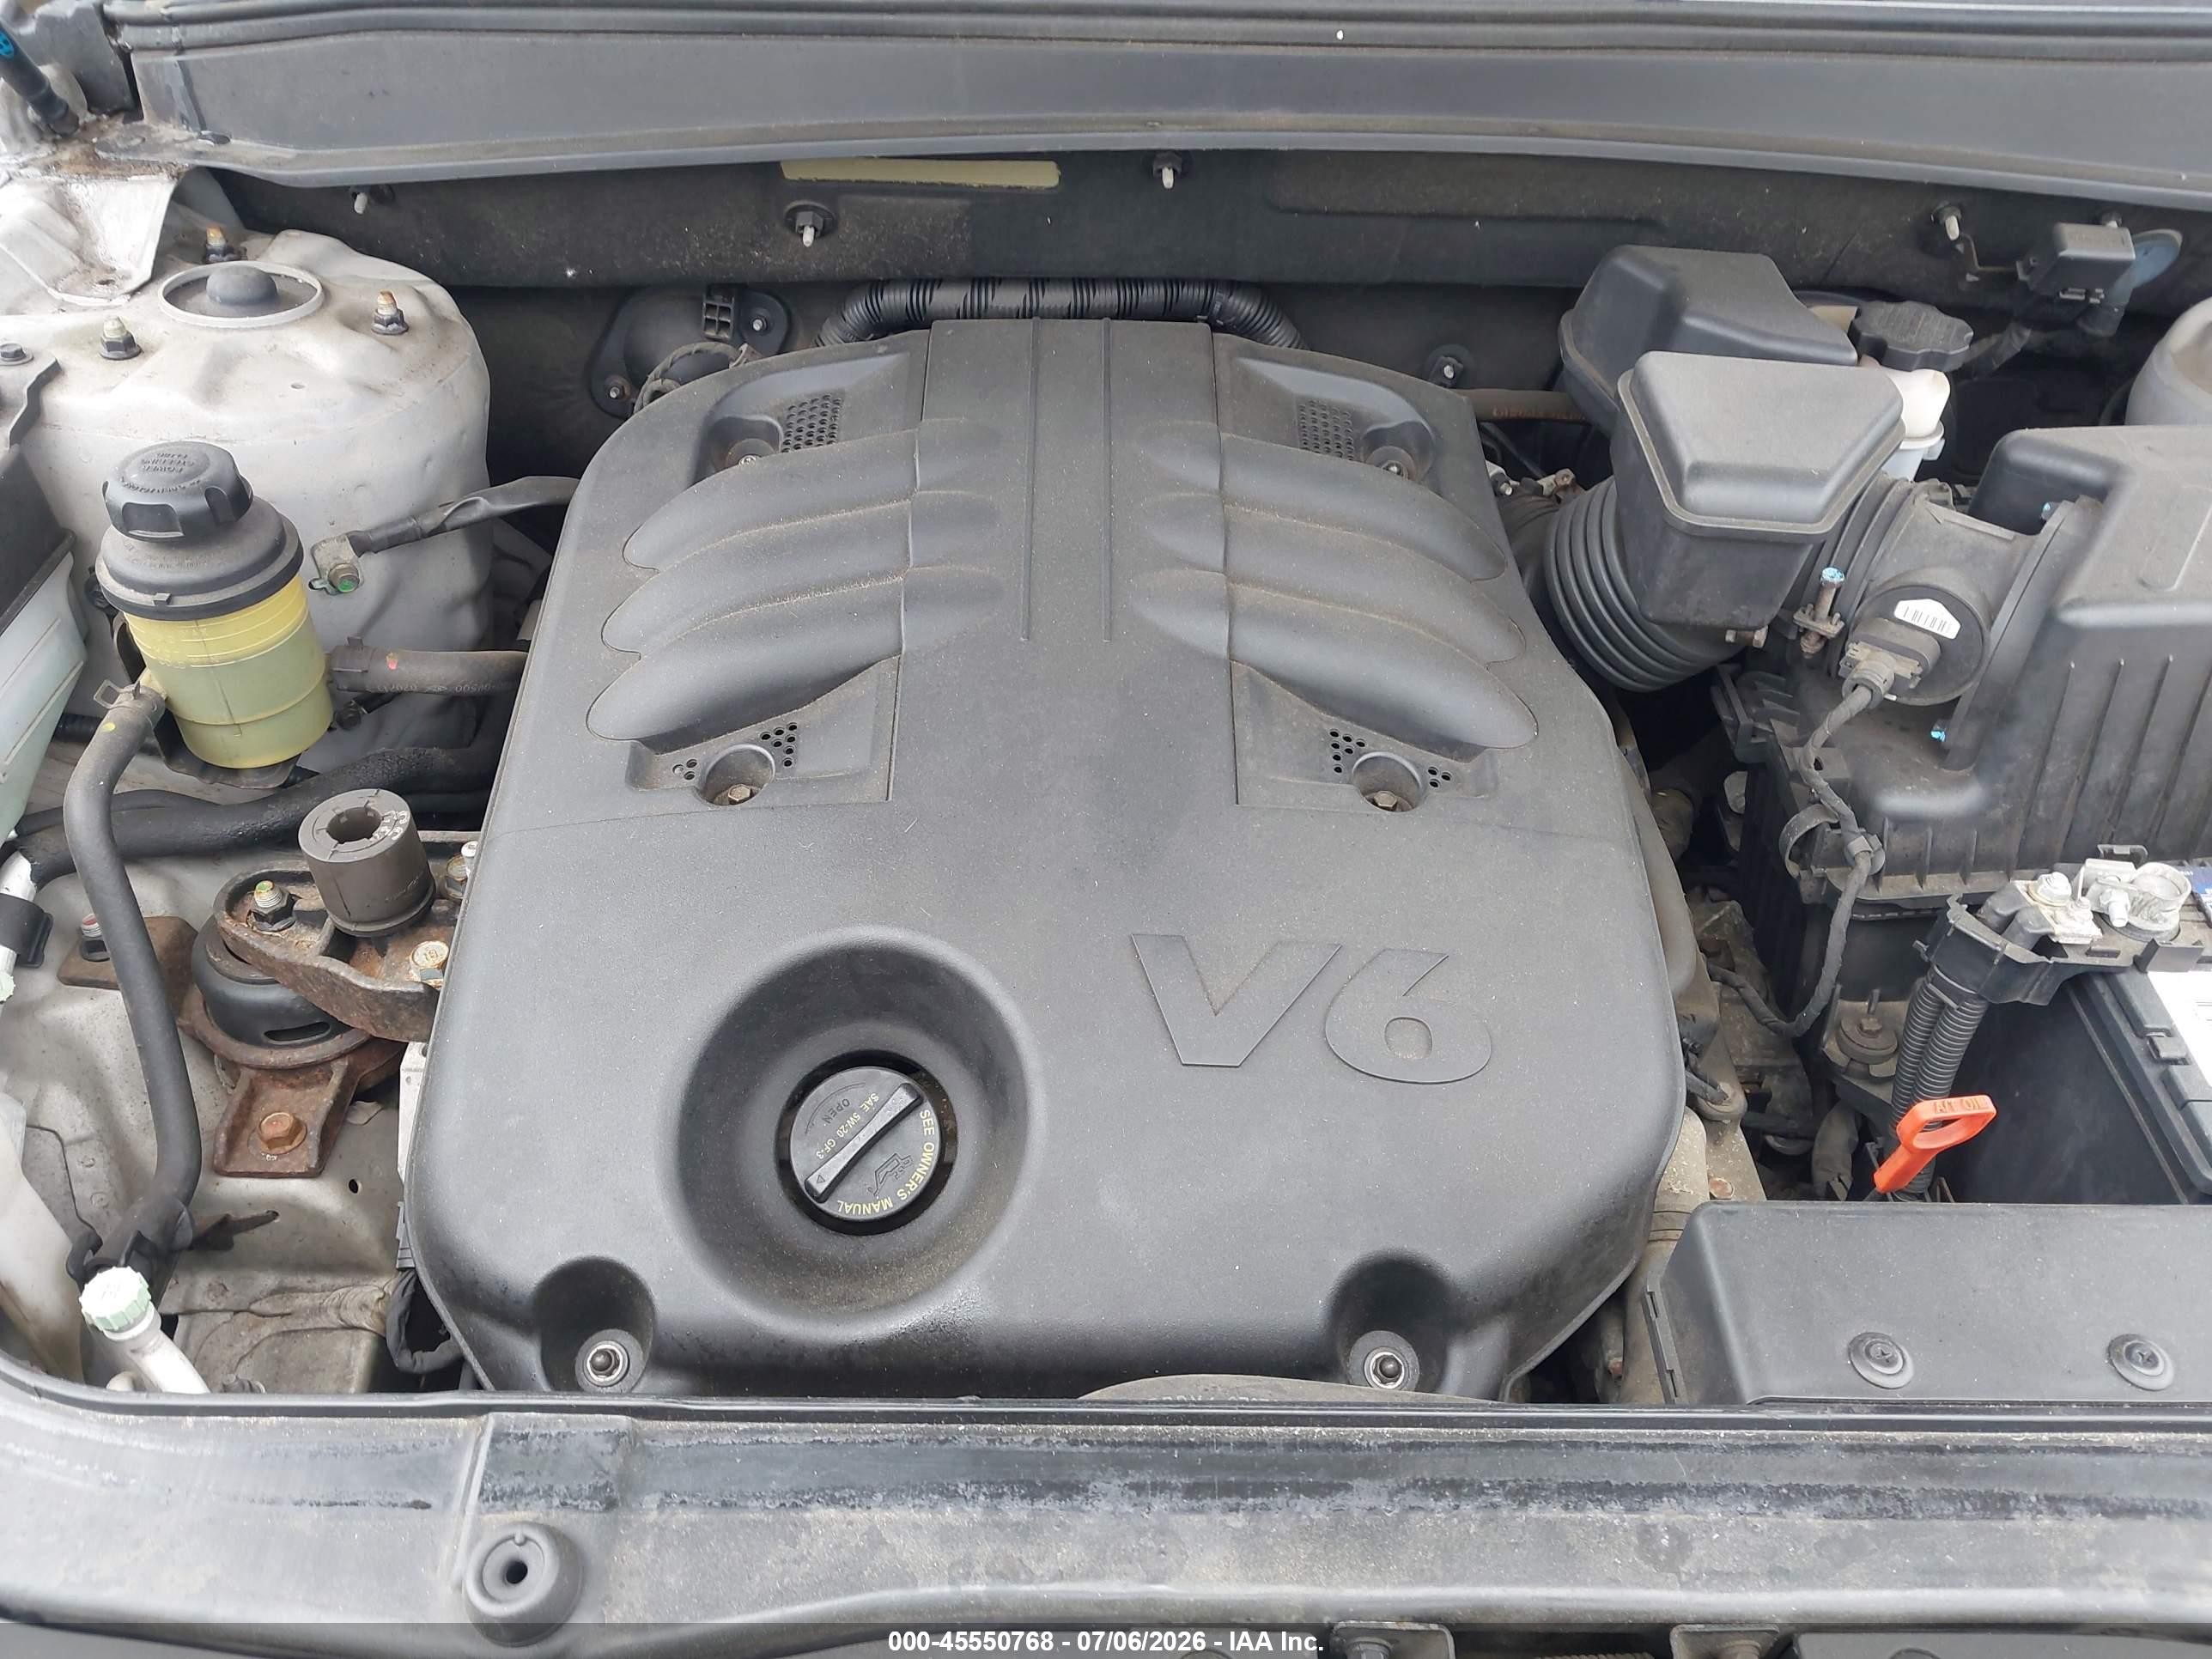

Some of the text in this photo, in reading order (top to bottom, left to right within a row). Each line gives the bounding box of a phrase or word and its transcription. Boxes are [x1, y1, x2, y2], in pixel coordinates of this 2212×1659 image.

[1130, 933, 1492, 1085] V6
[815, 1092, 880, 1160] SAE 5W-20 GF-3
[822, 1097, 851, 1125] OPEN
[836, 1109, 935, 1215] SEE OWNER'S MANUAL
